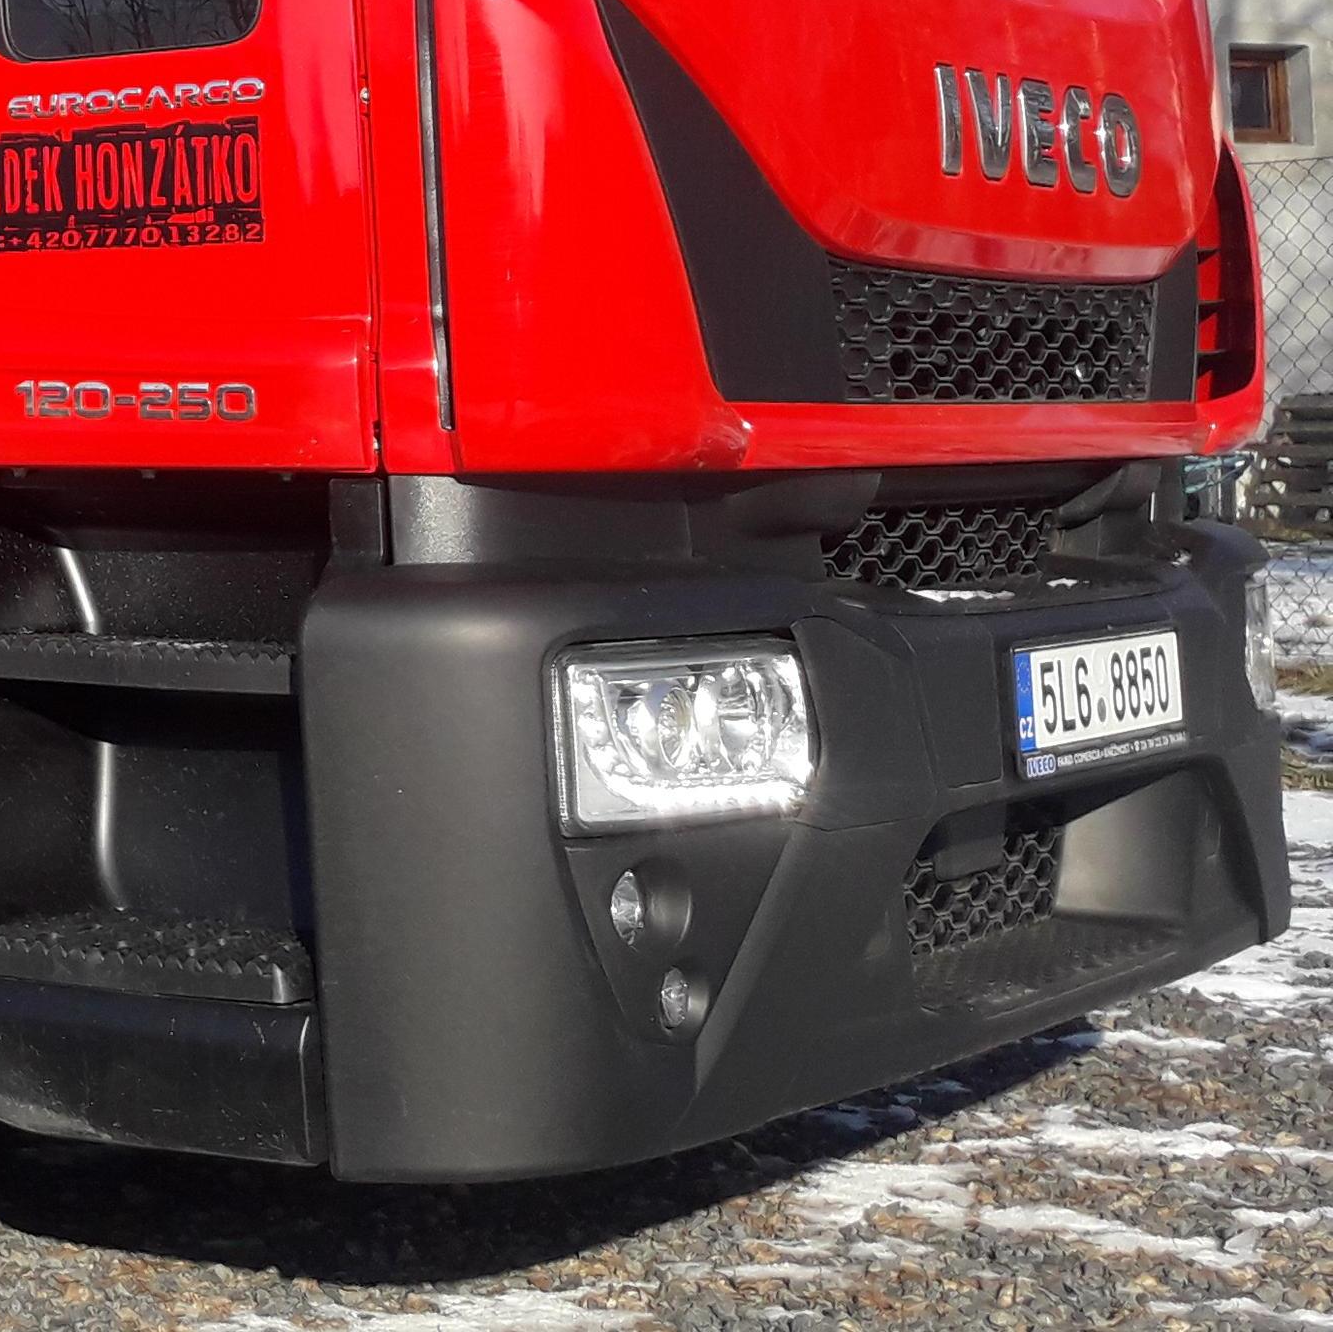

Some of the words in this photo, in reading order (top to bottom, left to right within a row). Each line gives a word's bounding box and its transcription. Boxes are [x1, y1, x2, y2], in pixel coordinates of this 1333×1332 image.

[8, 76, 265, 119] EUROCARGO
[933, 61, 1142, 198] IVECO
[74, 124, 259, 211] HONZÁTKO
[14, 379, 257, 422] 120-250
[1019, 716, 1033, 739] CZ
